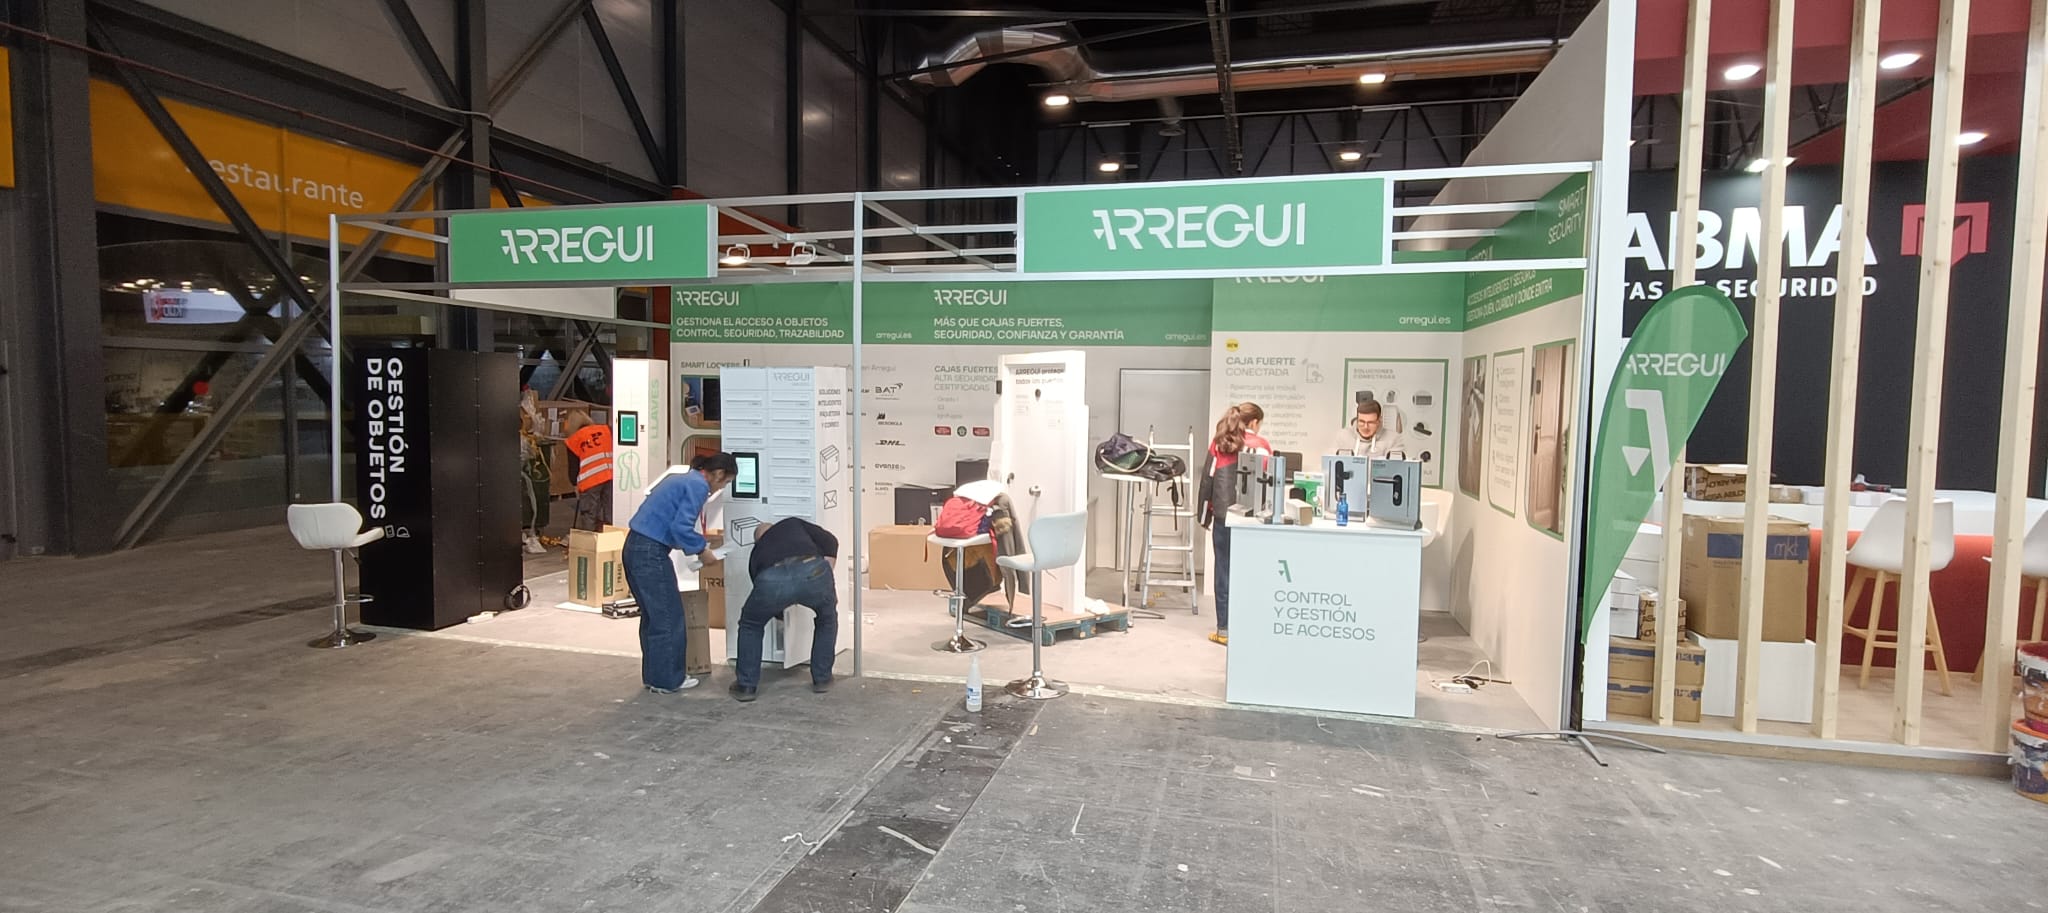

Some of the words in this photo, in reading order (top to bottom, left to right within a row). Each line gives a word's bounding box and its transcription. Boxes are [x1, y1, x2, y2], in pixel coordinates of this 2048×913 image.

[187, 158, 363, 209] estaurante
[1092, 202, 1306, 250] ARREGUI
[501, 225, 653, 264] ARREGUI
[676, 290, 740, 306] ARREGUI
[934, 289, 1007, 306] ARREGUI
[676, 317, 722, 327] GESTIONA
[723, 318, 734, 327] EL
[735, 317, 774, 327] ACCESO
[775, 318, 783, 327] A
[784, 317, 828, 327] OBJETOS
[934, 316, 956, 327] MÁS
[958, 318, 980, 328] QUE
[981, 318, 1015, 327] CAJAS
[1017, 318, 1064, 328] FUERTES,
[1399, 314, 1451, 326] arregui.es
[676, 328, 723, 338] CONTROL,
[724, 328, 778, 338] SEGURIDAD,
[779, 329, 845, 338] TRAZABILIDAD
[934, 329, 995, 340] SEGURIDAD,
[997, 329, 1058, 340] CONFIANZA
[1059, 330, 1068, 340] Y
[1068, 328, 1124, 340] GARANTÍA
[1226, 356, 1254, 366] CAJA
[1256, 356, 1296, 366] FUERTE
[1625, 353, 1726, 377] ARREGUI
[367, 358, 383, 391] DE
[1225, 367, 1289, 377] CONECTADA
[387, 357, 409, 473] GESTIÓN
[368, 399, 386, 519] OBJETOS
[1273, 590, 1352, 607] CONTROL
[1273, 606, 1284, 618] Y
[1286, 606, 1357, 623] GESTIÓN
[1273, 622, 1294, 635] DE
[1297, 624, 1376, 641] ACCESOS
